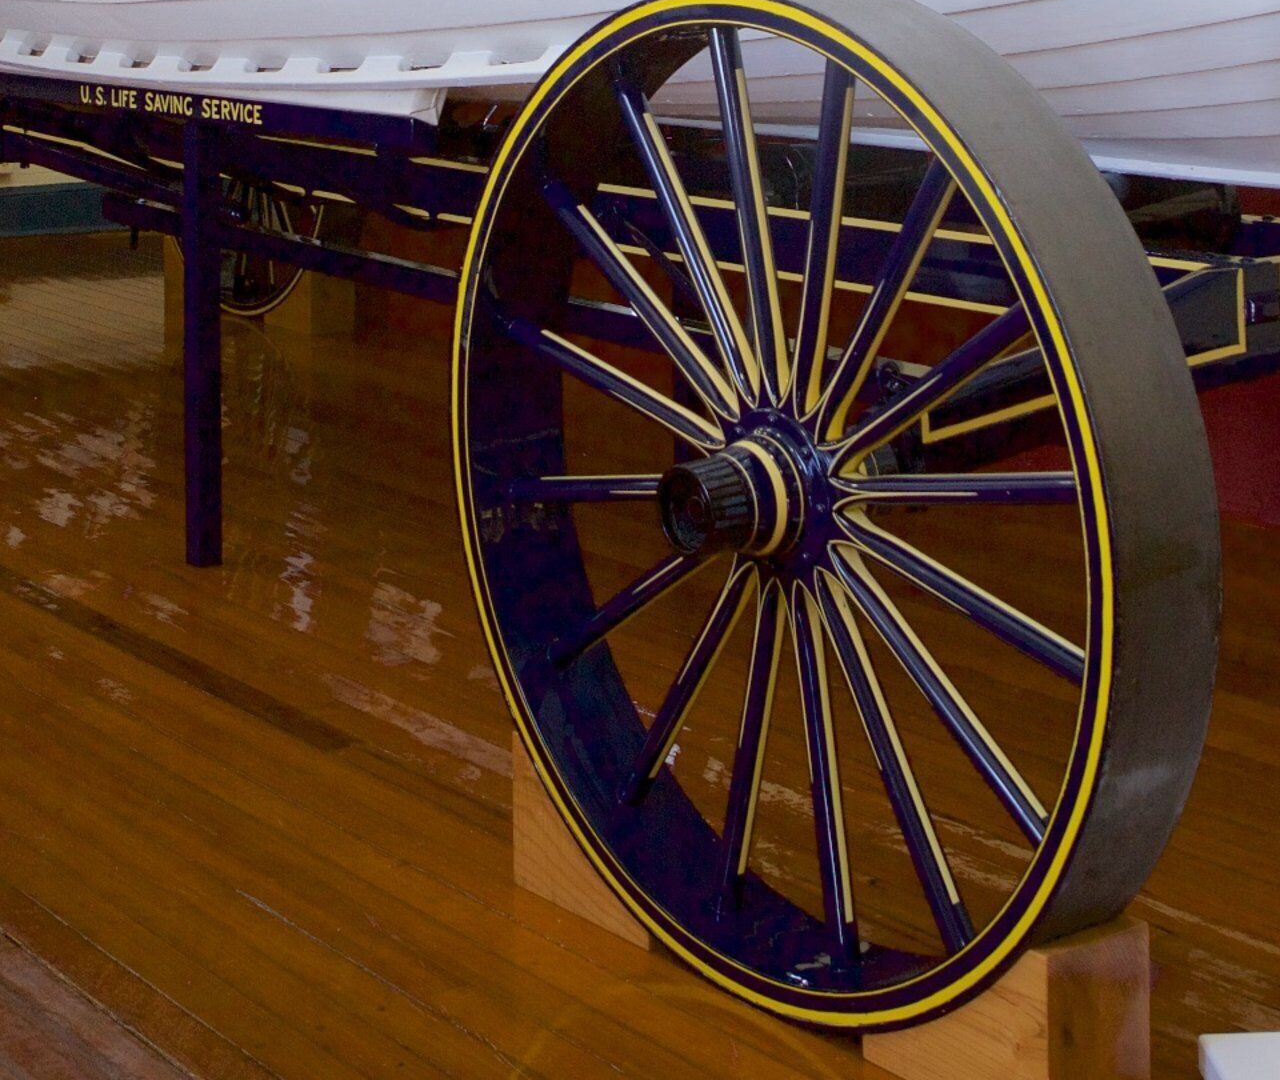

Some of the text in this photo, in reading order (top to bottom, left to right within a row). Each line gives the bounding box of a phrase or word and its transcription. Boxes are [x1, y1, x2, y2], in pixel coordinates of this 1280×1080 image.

[80, 85, 263, 125] U. S. LIFE SAVING SERVICE
